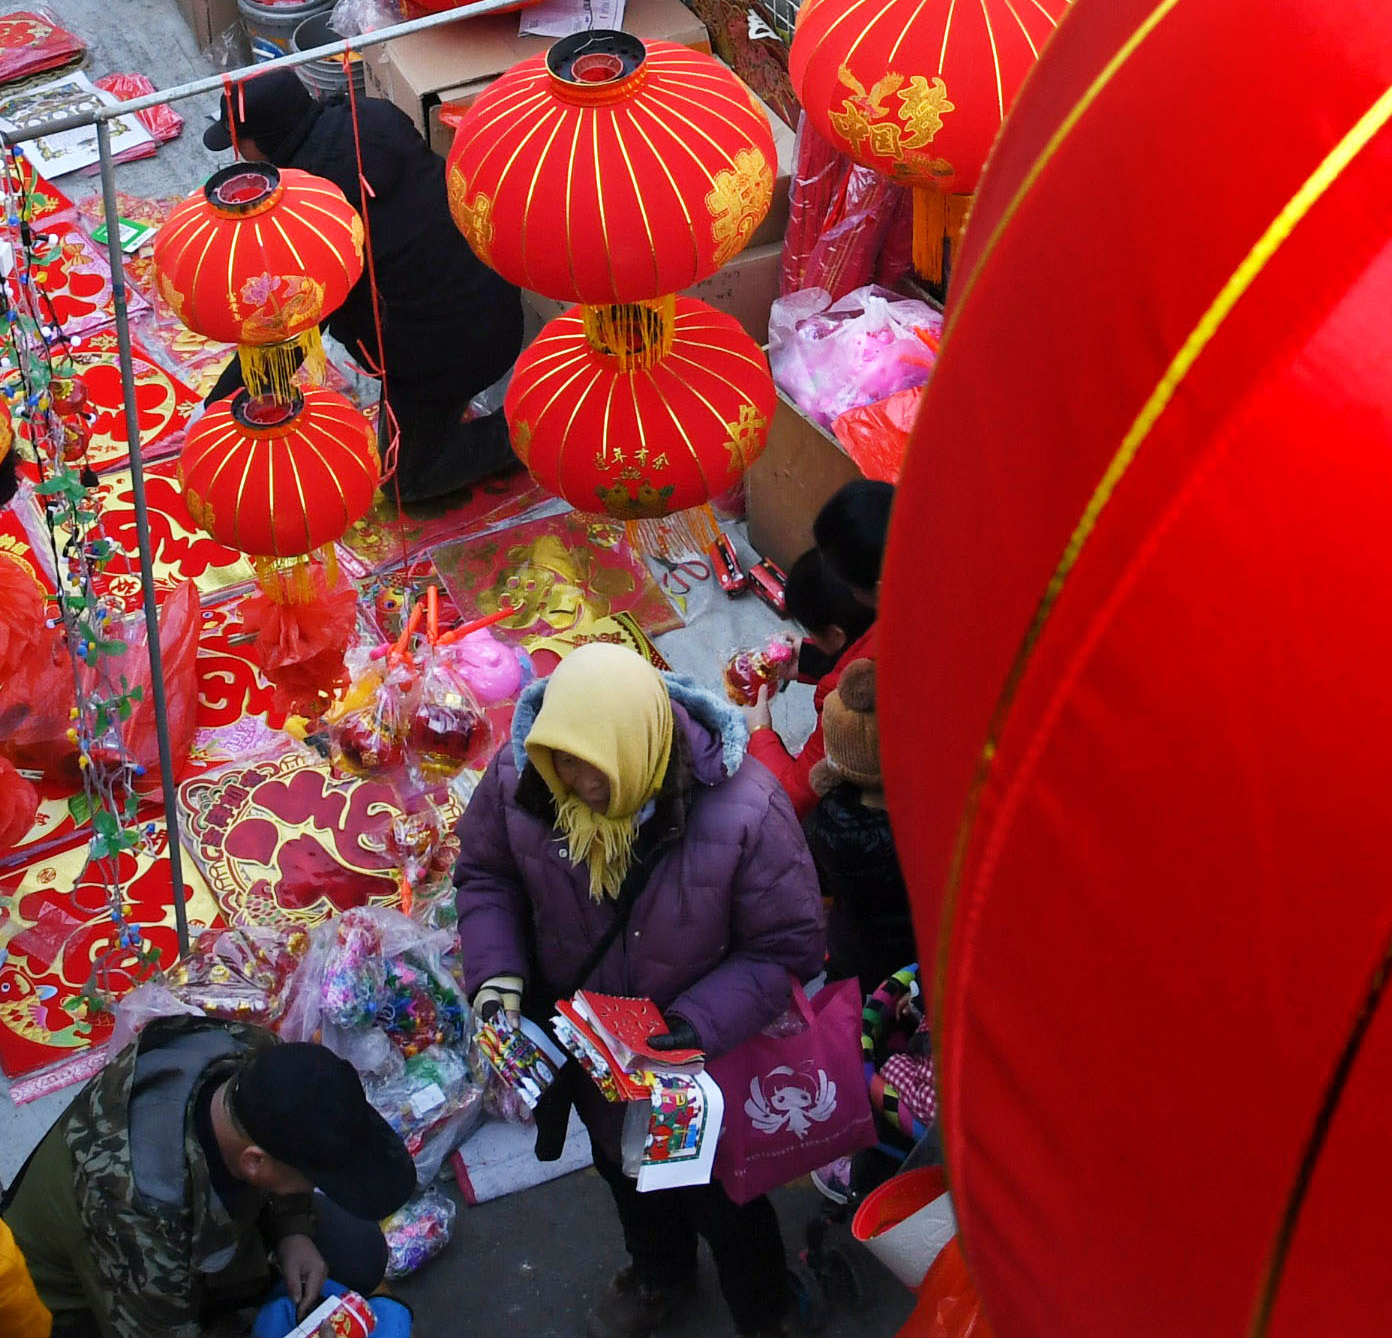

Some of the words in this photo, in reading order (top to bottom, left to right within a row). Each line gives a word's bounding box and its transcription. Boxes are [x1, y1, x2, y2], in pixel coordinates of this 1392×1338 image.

[827, 75, 956, 161] 中国梦
[11, 851, 194, 992] 福
